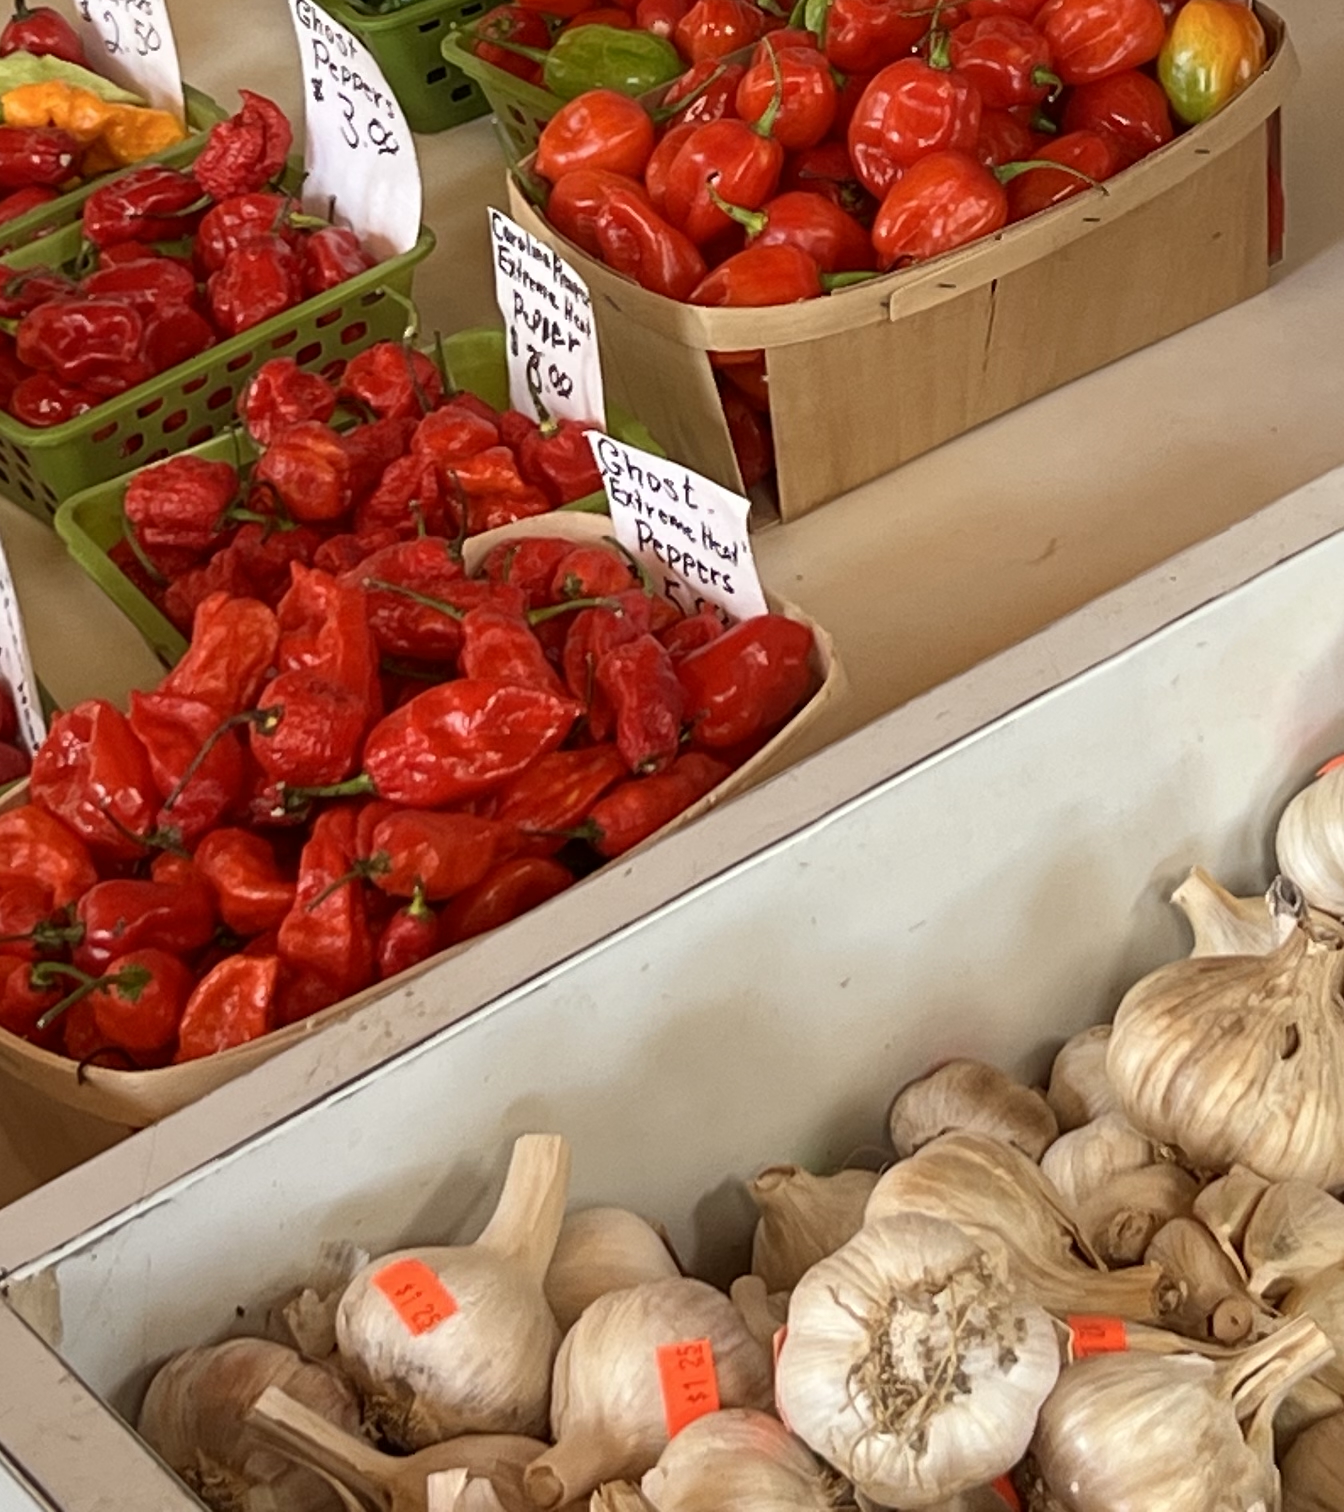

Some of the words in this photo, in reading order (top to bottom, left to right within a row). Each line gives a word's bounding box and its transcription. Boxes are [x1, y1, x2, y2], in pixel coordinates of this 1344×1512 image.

[312, 38, 396, 120] Peppers
[597, 438, 698, 510] Ghost
[634, 518, 735, 595] Peppers
